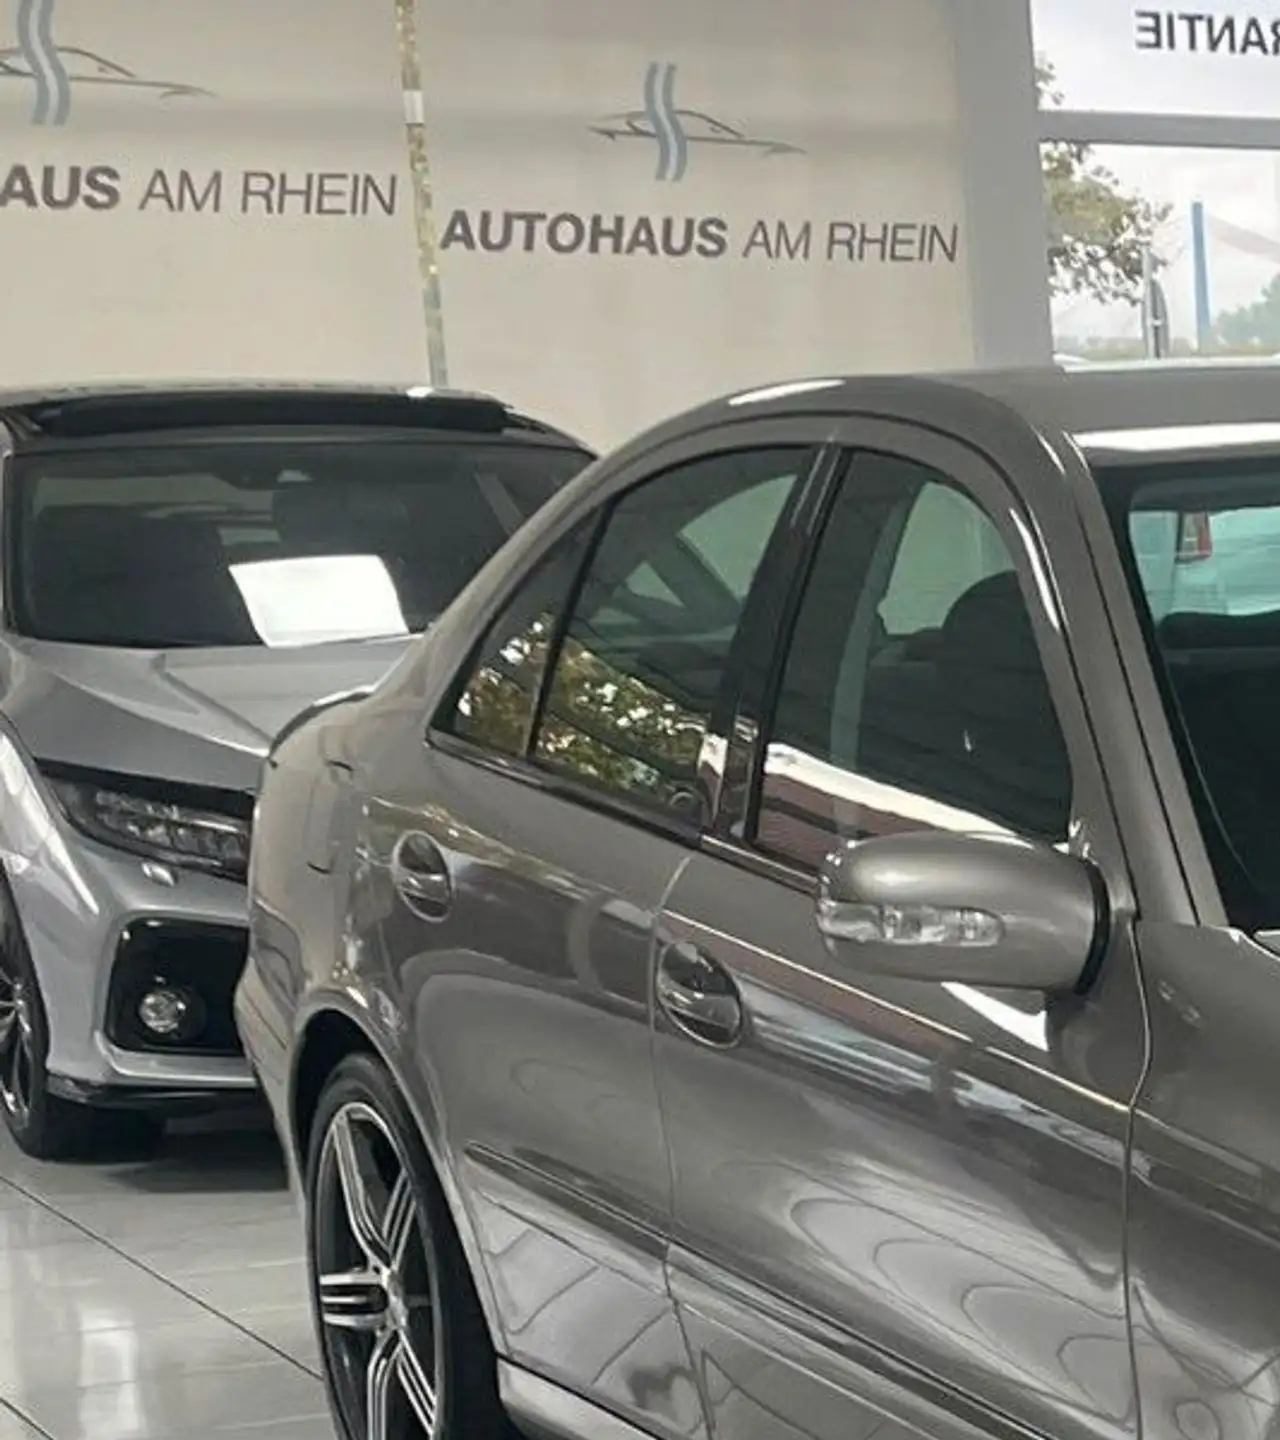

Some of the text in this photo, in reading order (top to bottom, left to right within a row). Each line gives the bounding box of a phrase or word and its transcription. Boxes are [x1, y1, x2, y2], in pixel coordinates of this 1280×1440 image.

[138, 168, 222, 213] AM
[241, 171, 397, 216] RHEIN
[440, 210, 958, 263] AUTOHAUS AM RHEIN
